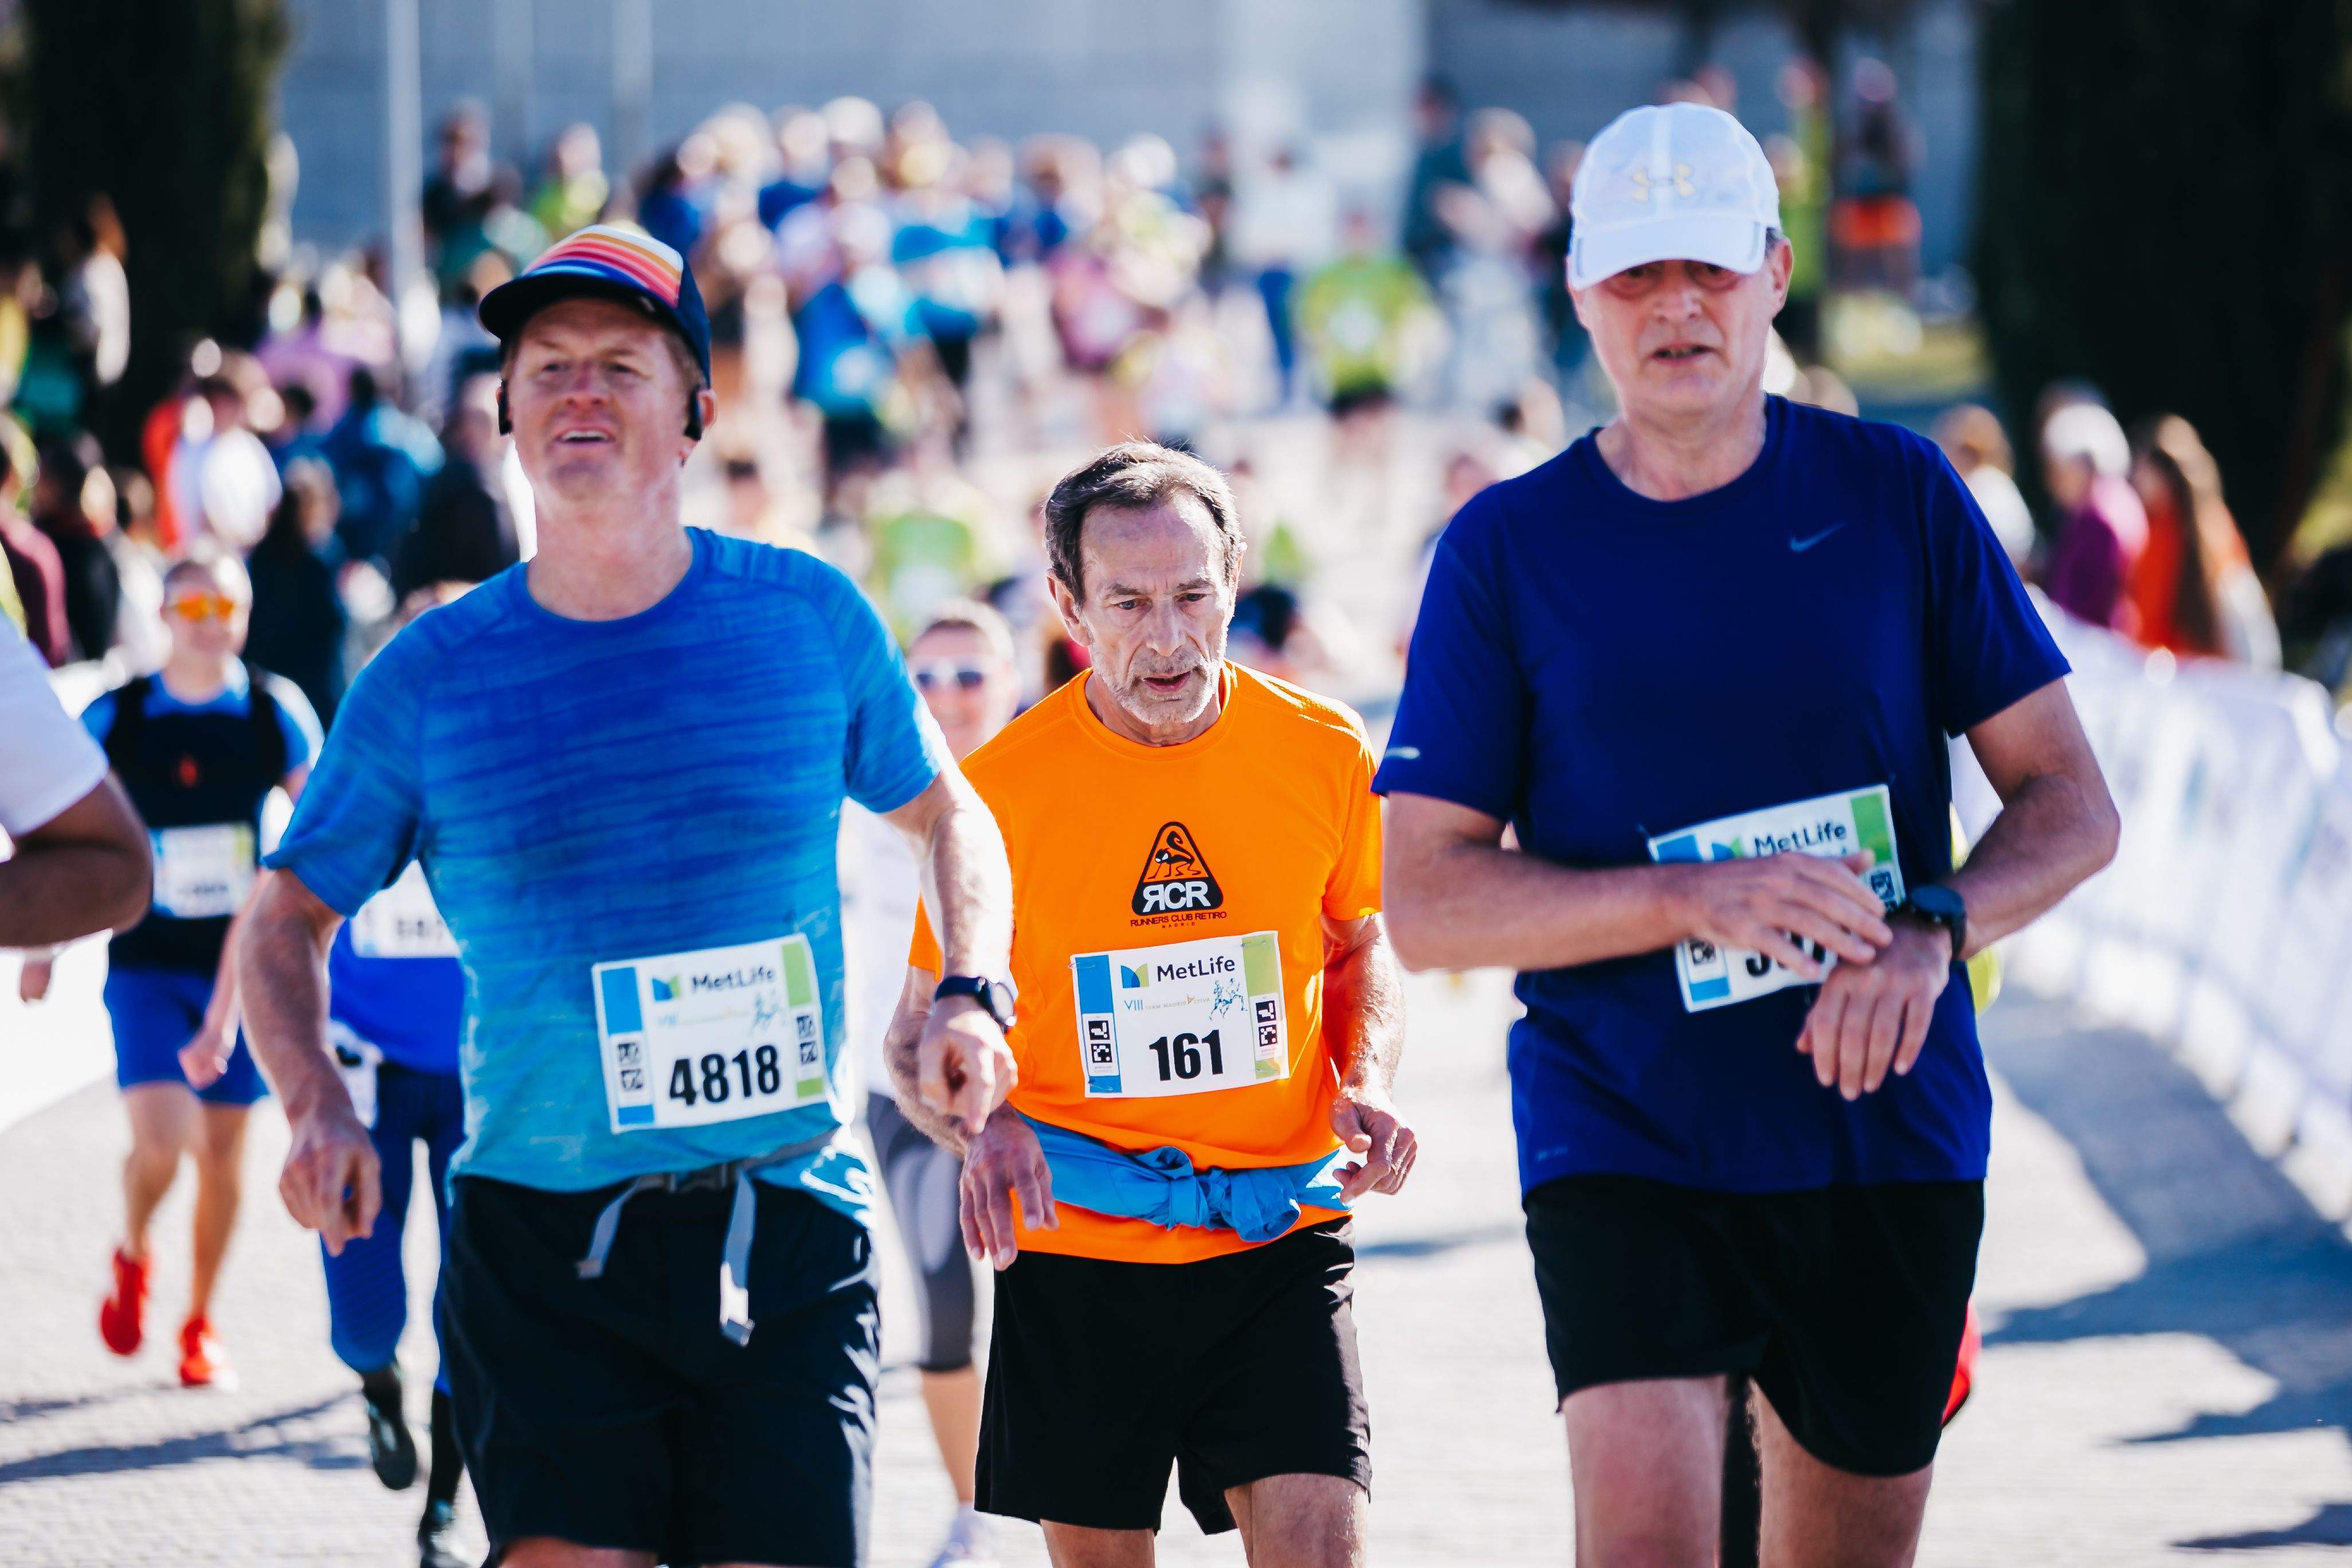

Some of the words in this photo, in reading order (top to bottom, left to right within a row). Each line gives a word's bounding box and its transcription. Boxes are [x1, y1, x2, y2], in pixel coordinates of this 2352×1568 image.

[1754, 821, 1847, 857] MetLife
[1130, 916, 1169, 927] RUNNERS
[1171, 913, 1193, 922] CLUB
[1195, 911, 1227, 920] RETIRO
[691, 966, 774, 990] MetLife
[1157, 956, 1236, 982] MetLife
[1124, 999, 1143, 1011] VIII
[1148, 1029, 1224, 1081] 161
[669, 1045, 780, 1106] 4818
